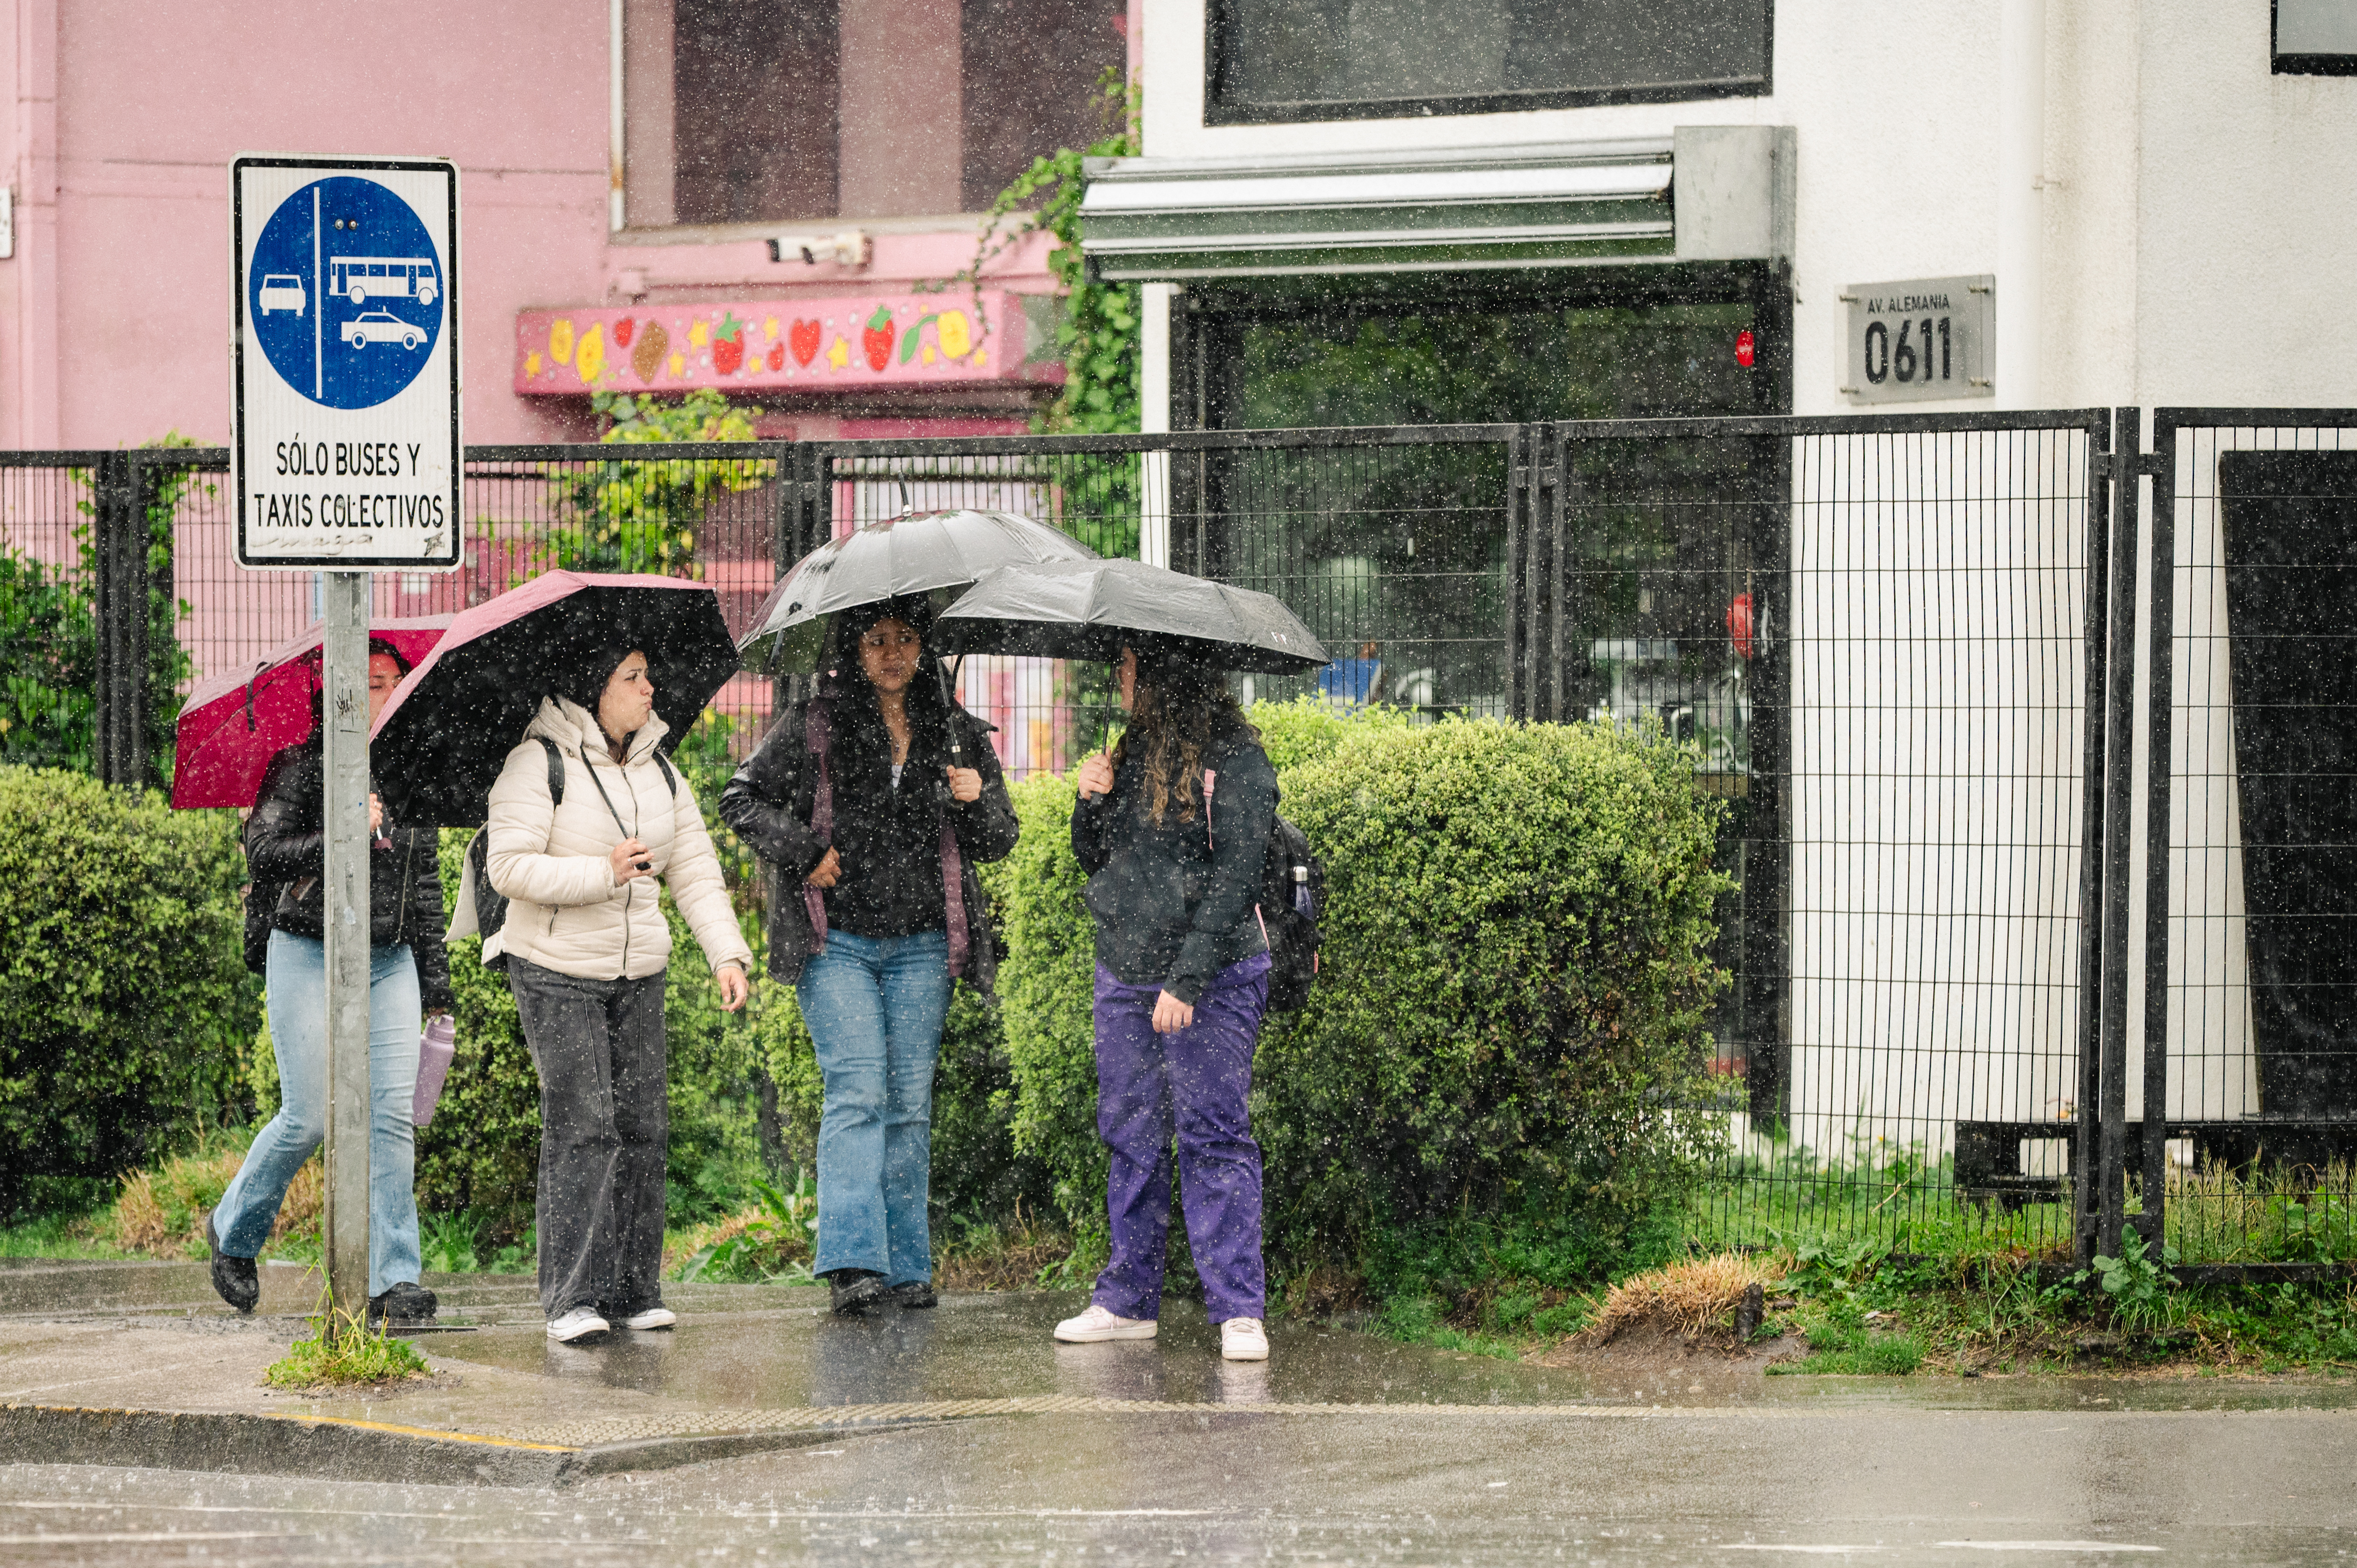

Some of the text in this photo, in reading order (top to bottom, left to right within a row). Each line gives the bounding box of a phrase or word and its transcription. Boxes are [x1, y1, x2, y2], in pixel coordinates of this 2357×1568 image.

[1867, 293, 1950, 314] AV. ALEMANIA
[1865, 317, 1951, 385] 0611
[276, 432, 421, 476] SÓLO BUSES Y
[254, 493, 444, 528] TAXIS COLECTIVOS
